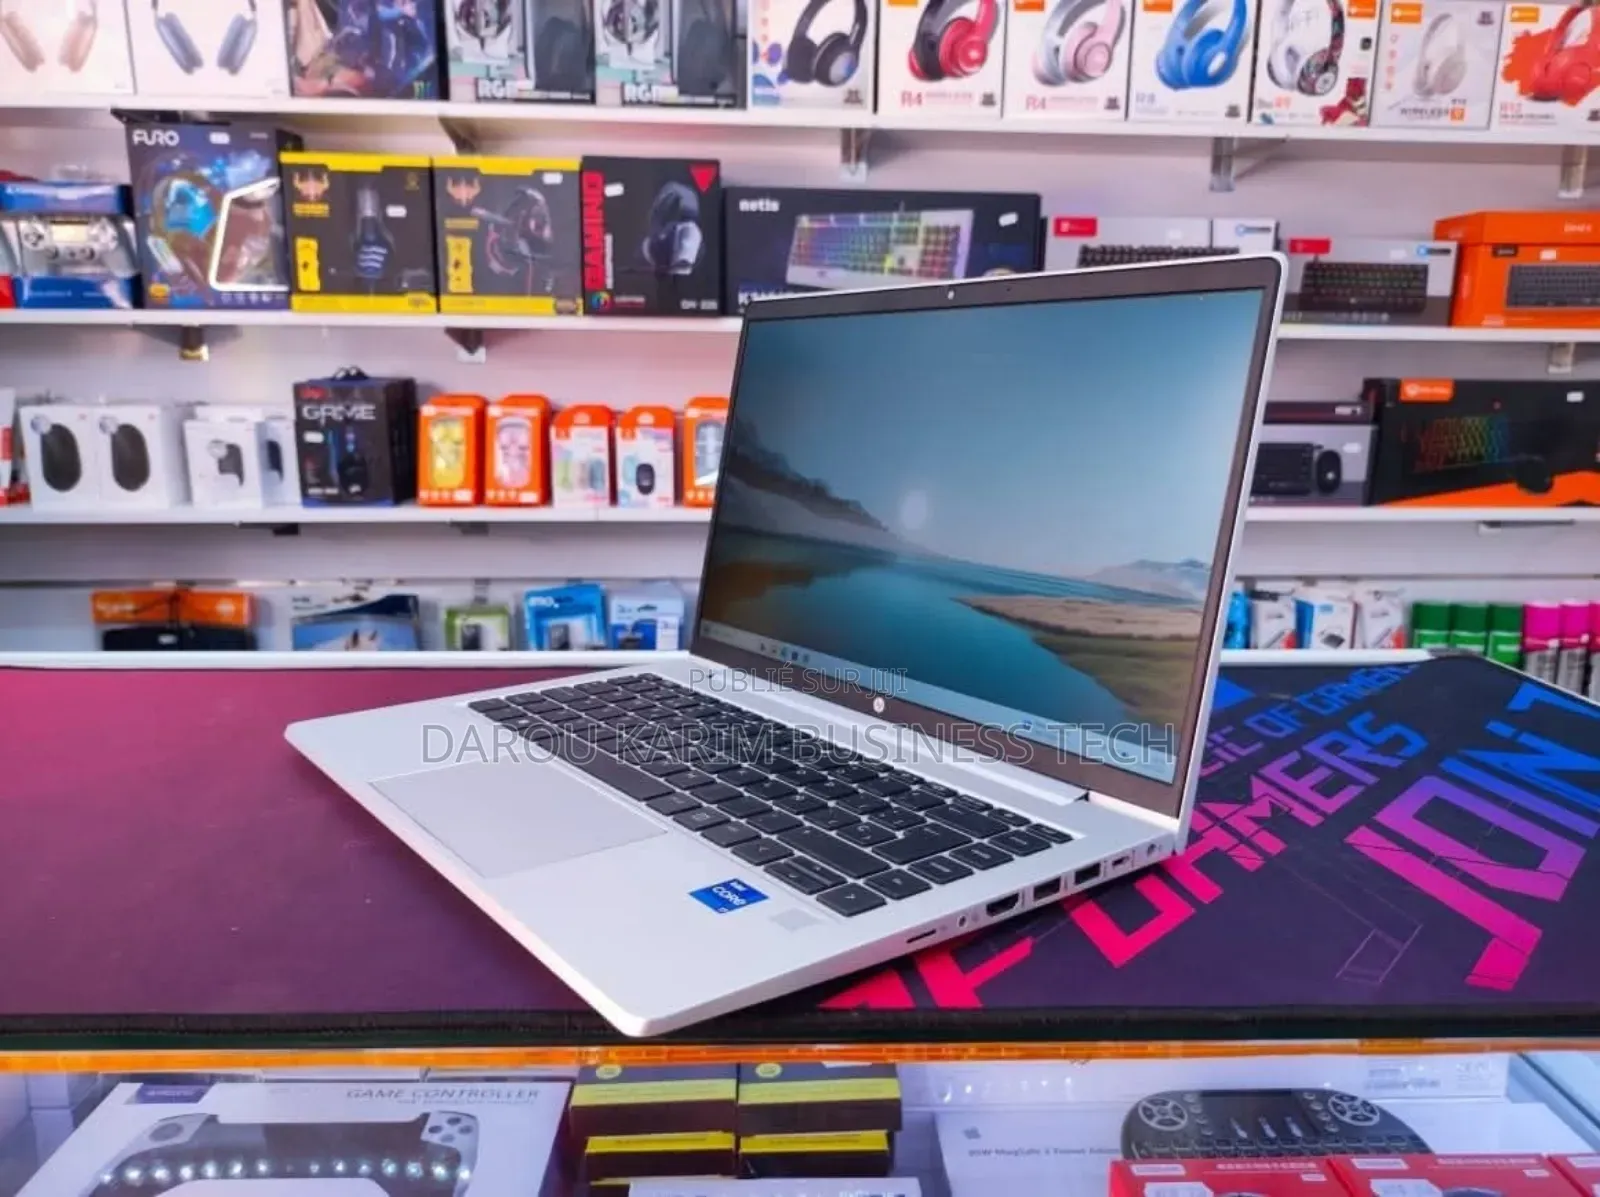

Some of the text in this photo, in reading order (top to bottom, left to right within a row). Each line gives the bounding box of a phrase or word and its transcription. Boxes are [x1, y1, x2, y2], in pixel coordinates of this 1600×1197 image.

[132, 129, 180, 146] FURO
[739, 198, 779, 212] netis
[347, 1088, 540, 1100] GAME CONTROLLER
